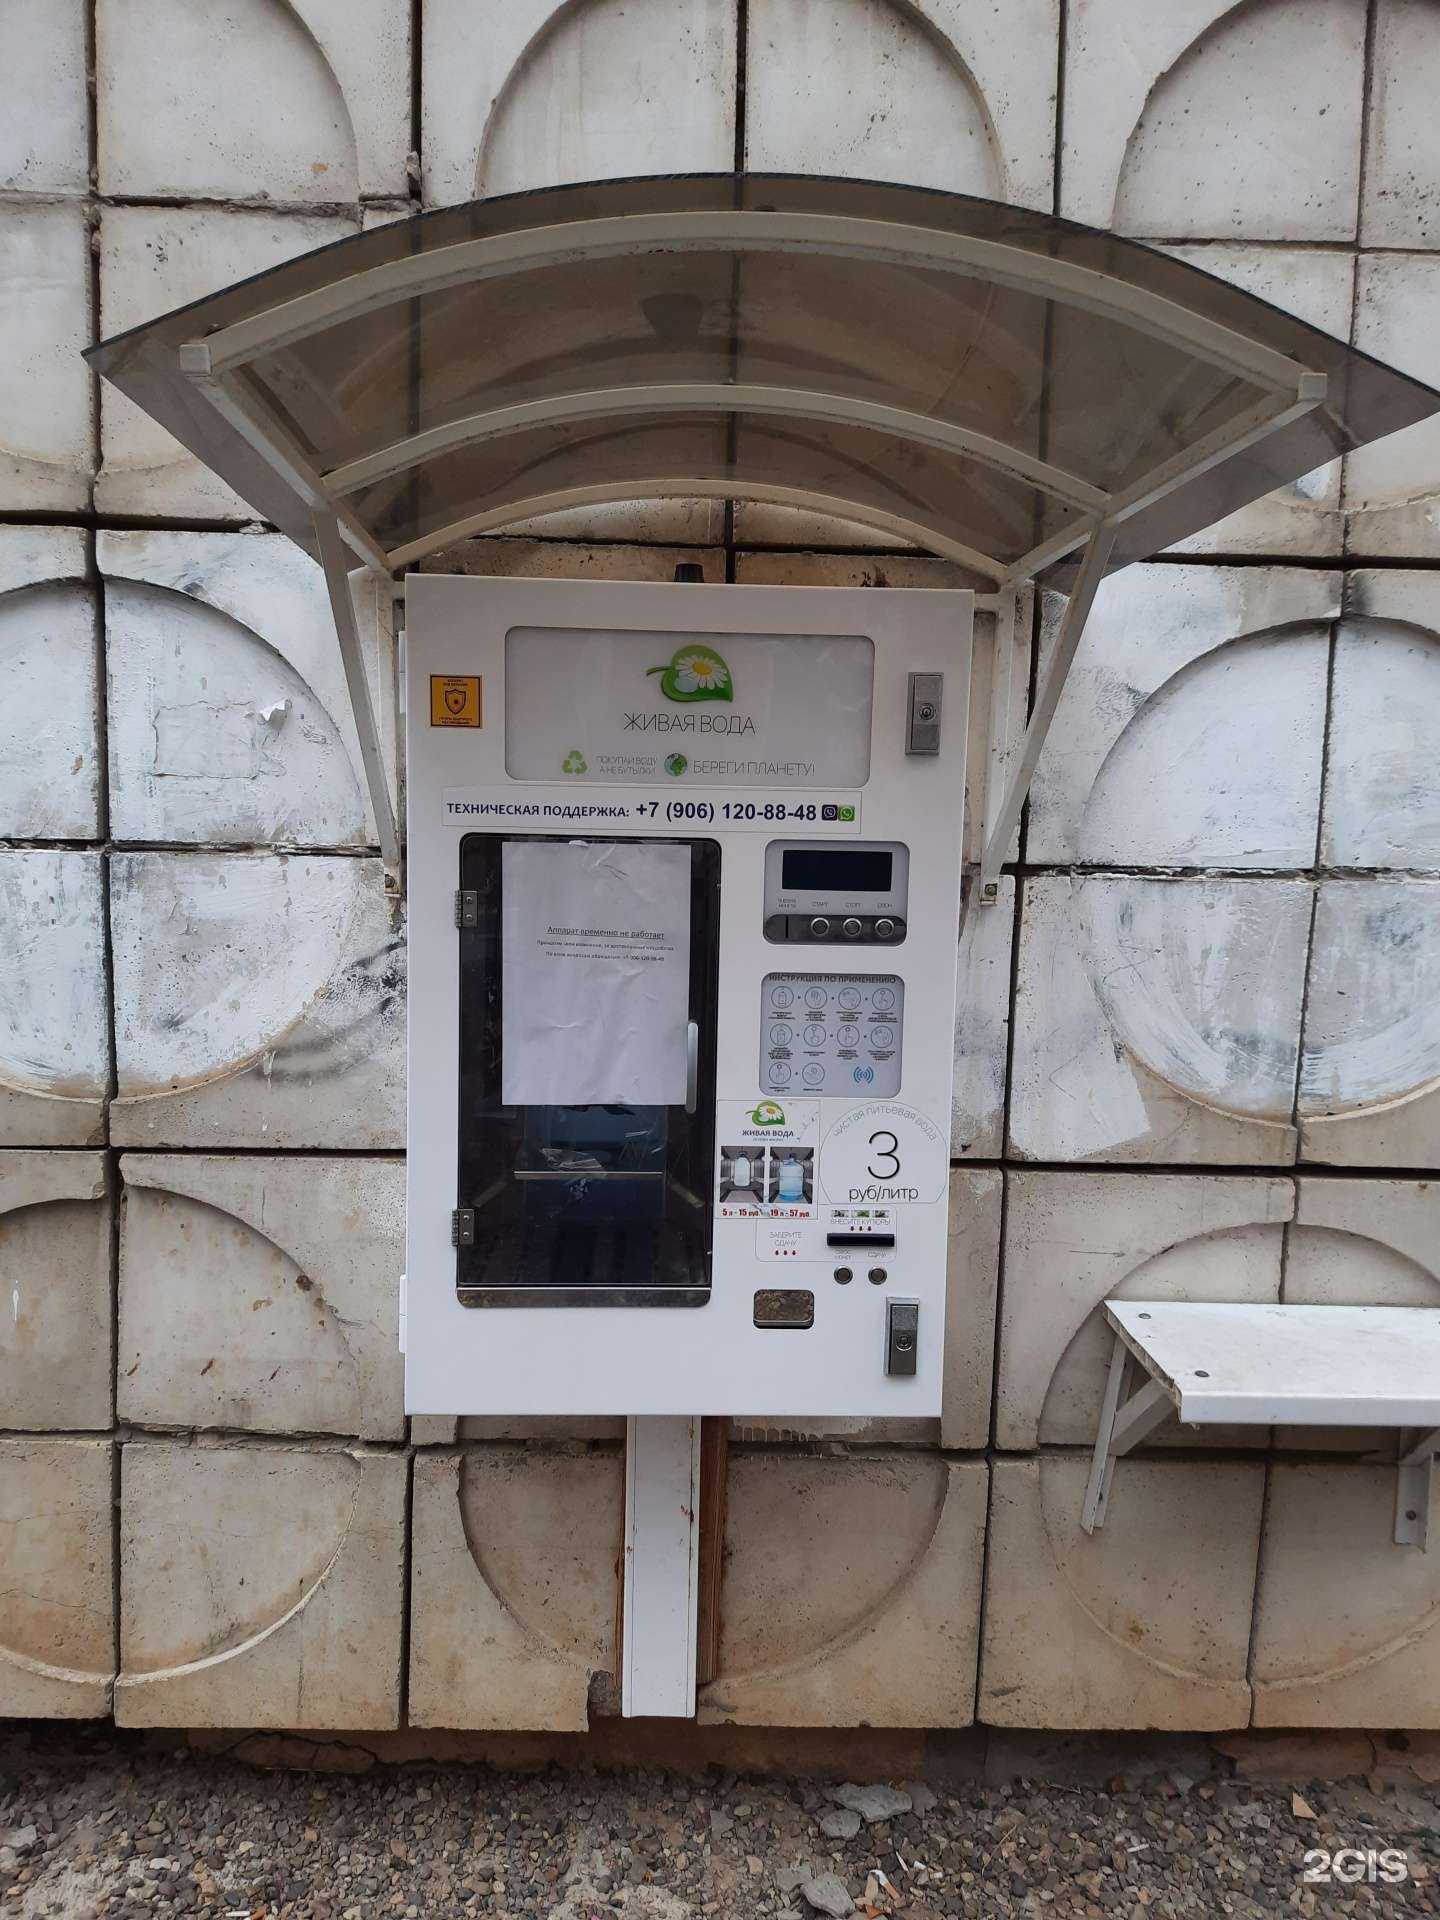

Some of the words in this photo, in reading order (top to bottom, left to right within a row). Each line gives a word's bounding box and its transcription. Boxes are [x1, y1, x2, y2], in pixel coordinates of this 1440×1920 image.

[623, 713, 695, 733] ЖИВАЯ
[700, 715, 756, 736] ВОДА
[693, 760, 744, 774] БЕРЕГИ
[746, 762, 815, 777] ПЛАНЕТУ!
[447, 803, 540, 816] ТЕХНИЧЕСКАЯ
[543, 805, 630, 818] ПОДДЕРЖКА:
[635, 802, 660, 818] +7
[666, 802, 715, 822] (906)
[722, 804, 817, 821] 120-88-48
[547, 926, 579, 936] Аппарат
[580, 928, 619, 936] временно
[631, 930, 665, 940] работает
[824, 975, 836, 983] ПО
[866, 1105, 916, 1120] питьевая
[742, 1129, 771, 1137] ЖИВАЯ
[772, 1130, 794, 1138] ВОДА
[868, 1130, 900, 1180] 3
[849, 1185, 919, 1202] руб/литр
[770, 1209, 779, 1217] 19
